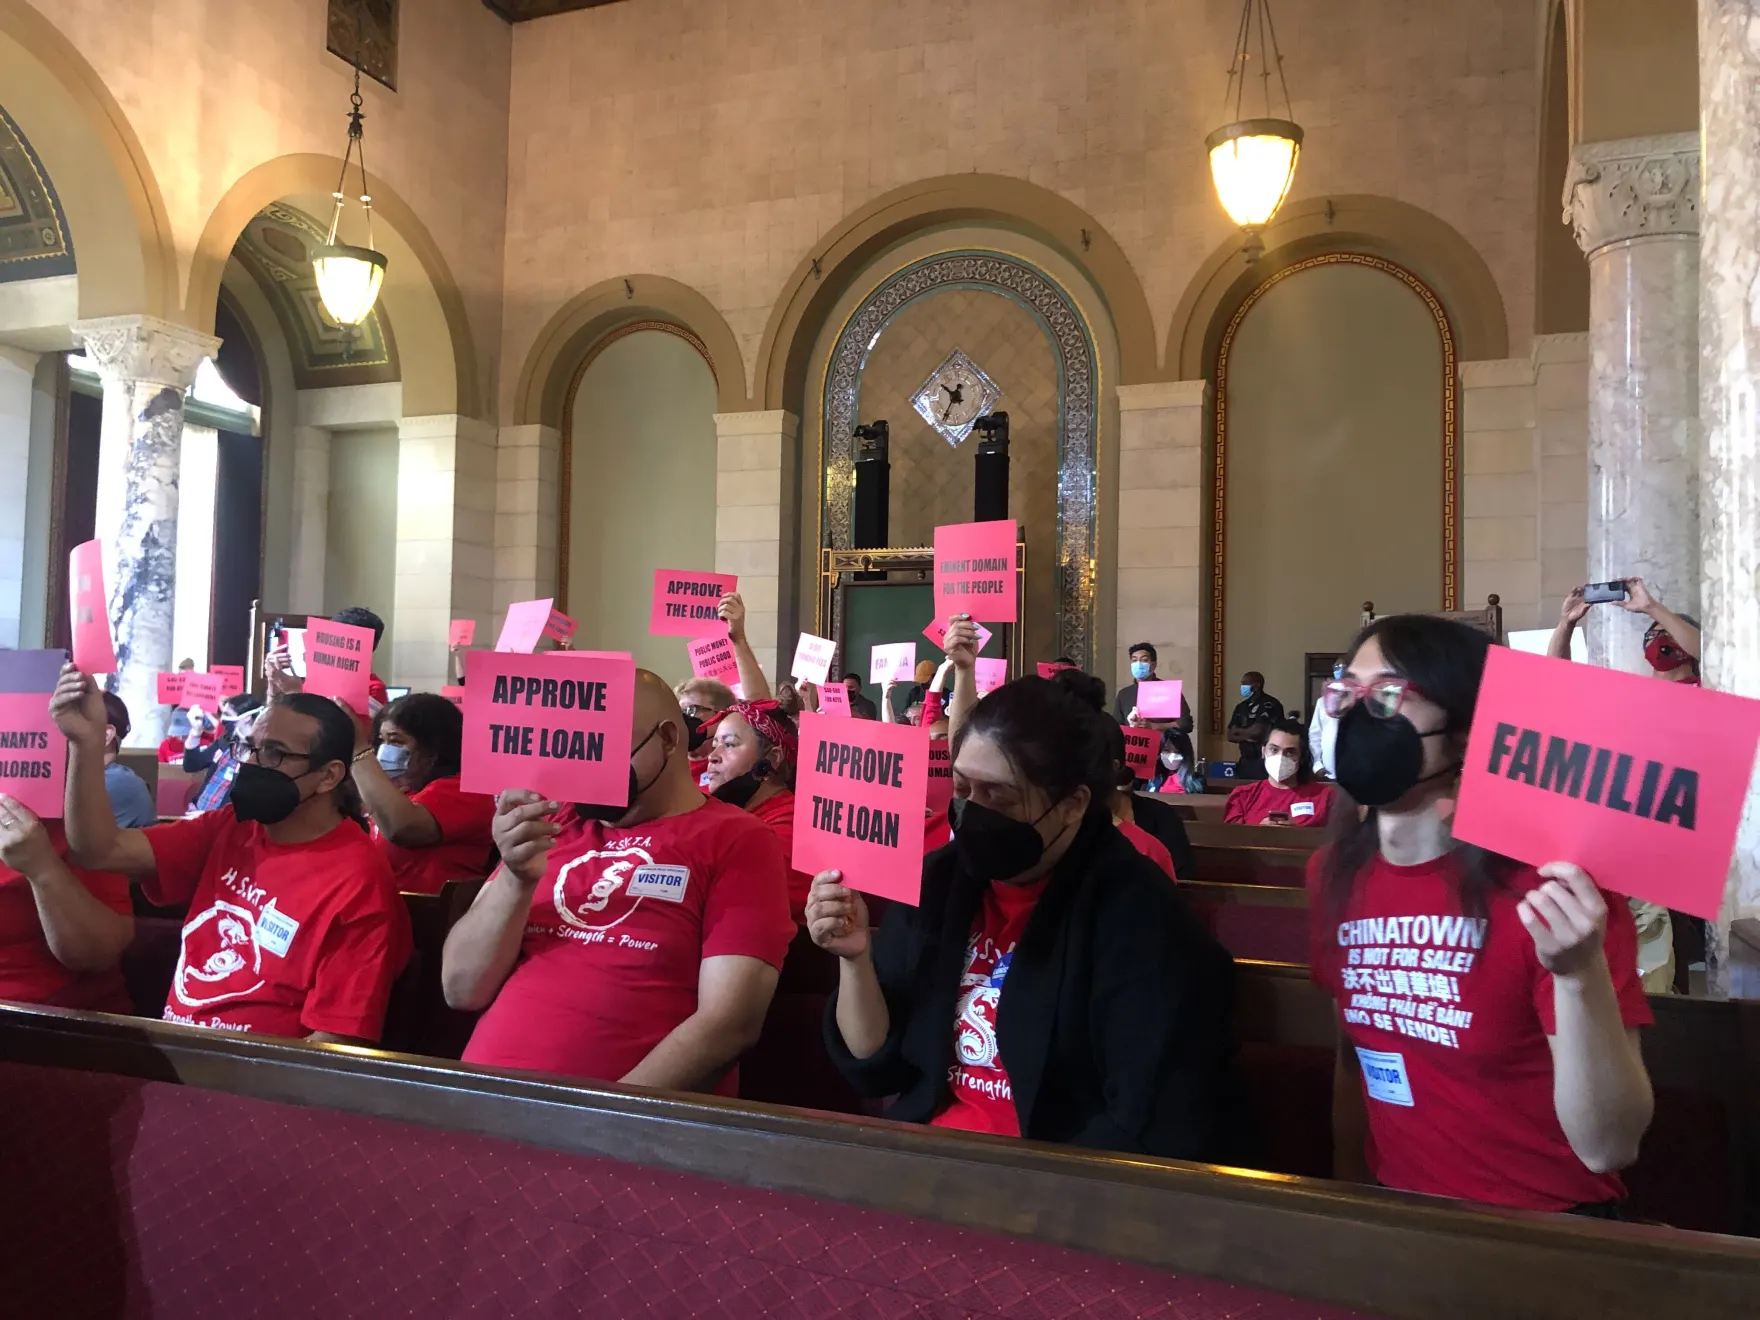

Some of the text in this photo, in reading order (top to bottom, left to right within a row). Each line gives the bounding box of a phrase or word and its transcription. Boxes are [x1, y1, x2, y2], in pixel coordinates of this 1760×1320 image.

[940, 558, 1007, 574] EMINENT DOMAIN
[667, 580, 722, 598] APPROVE
[943, 580, 1003, 595] FOR THE PEOPLE
[666, 603, 687, 618] THE
[316, 631, 361, 652] HOUSING IS A
[695, 639, 728, 656] PUBLIC MONEY
[313, 651, 360, 672] HUMAN RIGHT
[699, 651, 731, 668] PUBLIC GOOD
[492, 675, 607, 712] APPROVE
[0, 732, 48, 749] NANTS
[490, 724, 604, 762] THE LOAN
[1124, 734, 1150, 748] ROVE
[815, 740, 904, 788] APPROVE
[1487, 721, 1699, 831] FAMILIA
[812, 795, 899, 848] THE LOAN
[638, 873, 682, 887] VISITOR
[261, 917, 290, 941] VISITOR
[556, 925, 605, 944] Strength
[619, 934, 658, 951] Power
[1337, 915, 1488, 949] CHINATOWN
[1348, 948, 1475, 973] IS NOT FOR SALE!
[1372, 1012, 1394, 1031] SE
[947, 1065, 1011, 1100] Strength
